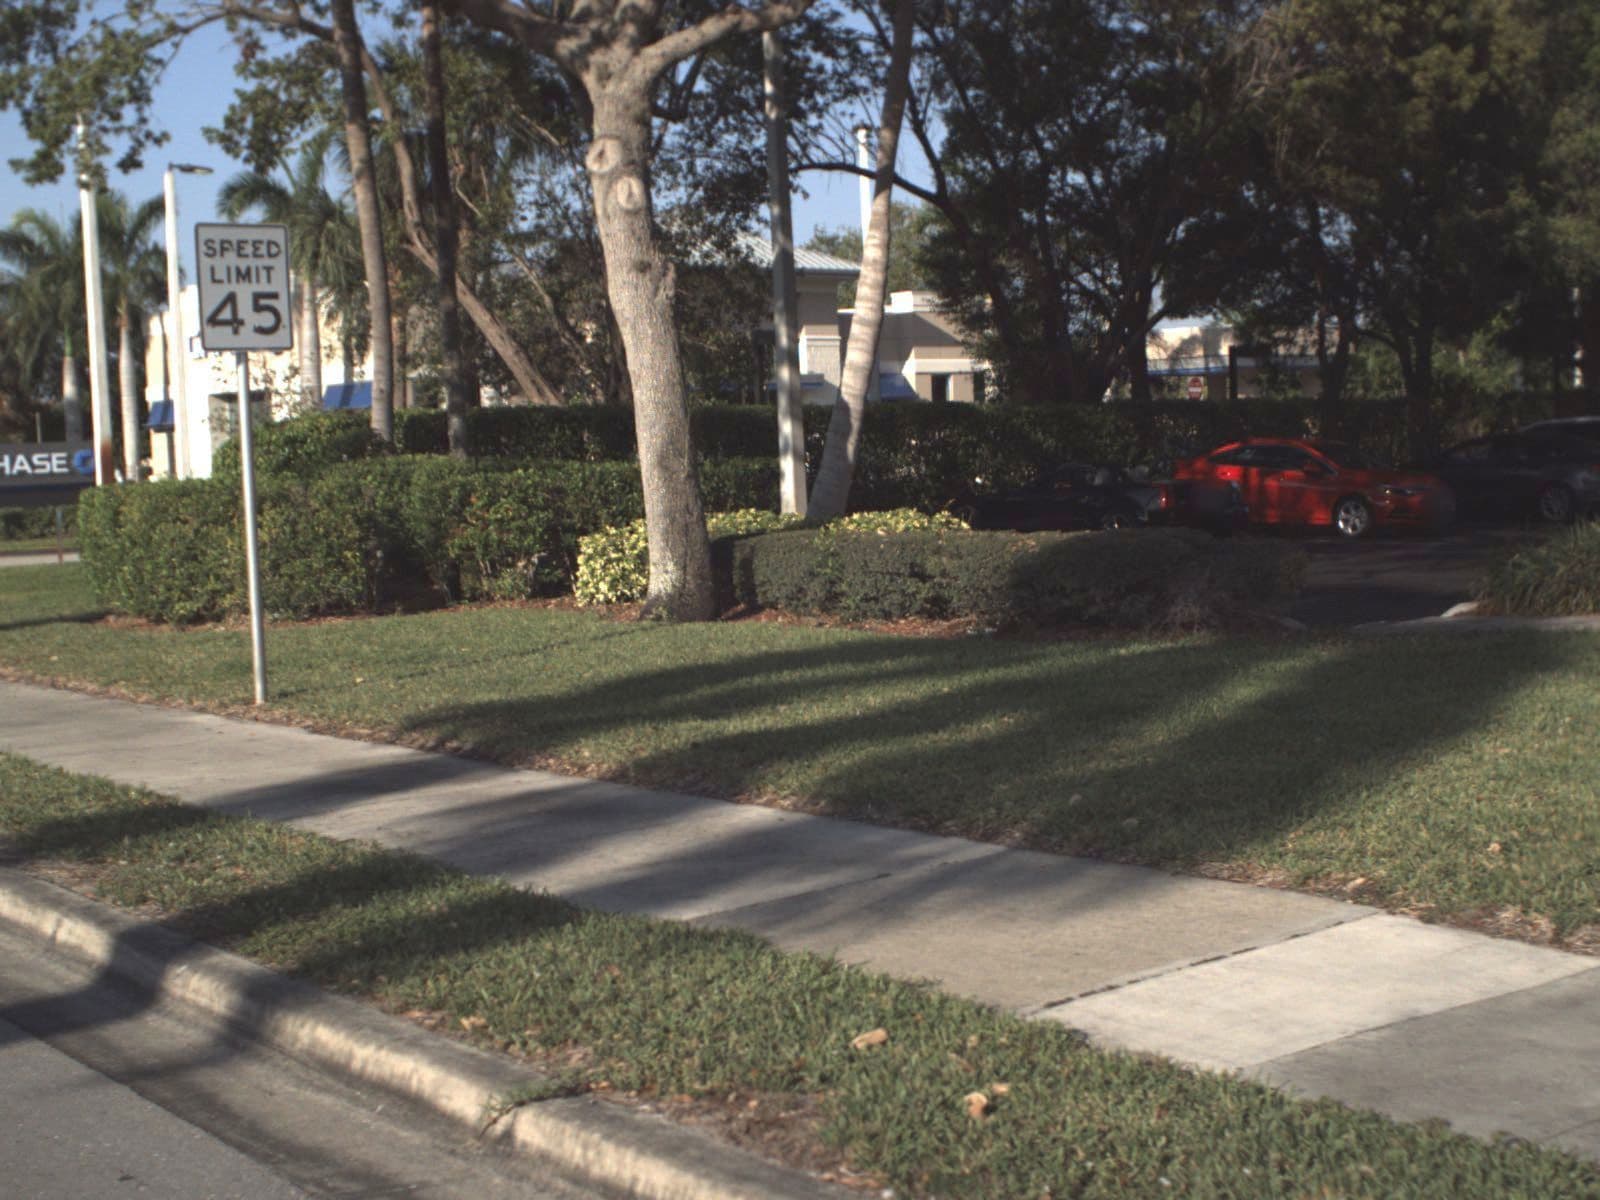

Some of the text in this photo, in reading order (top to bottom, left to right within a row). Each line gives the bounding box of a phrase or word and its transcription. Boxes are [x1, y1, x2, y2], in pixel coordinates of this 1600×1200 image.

[203, 239, 282, 258] SPEED
[210, 265, 275, 284] LIMIT
[206, 291, 283, 336] 45
